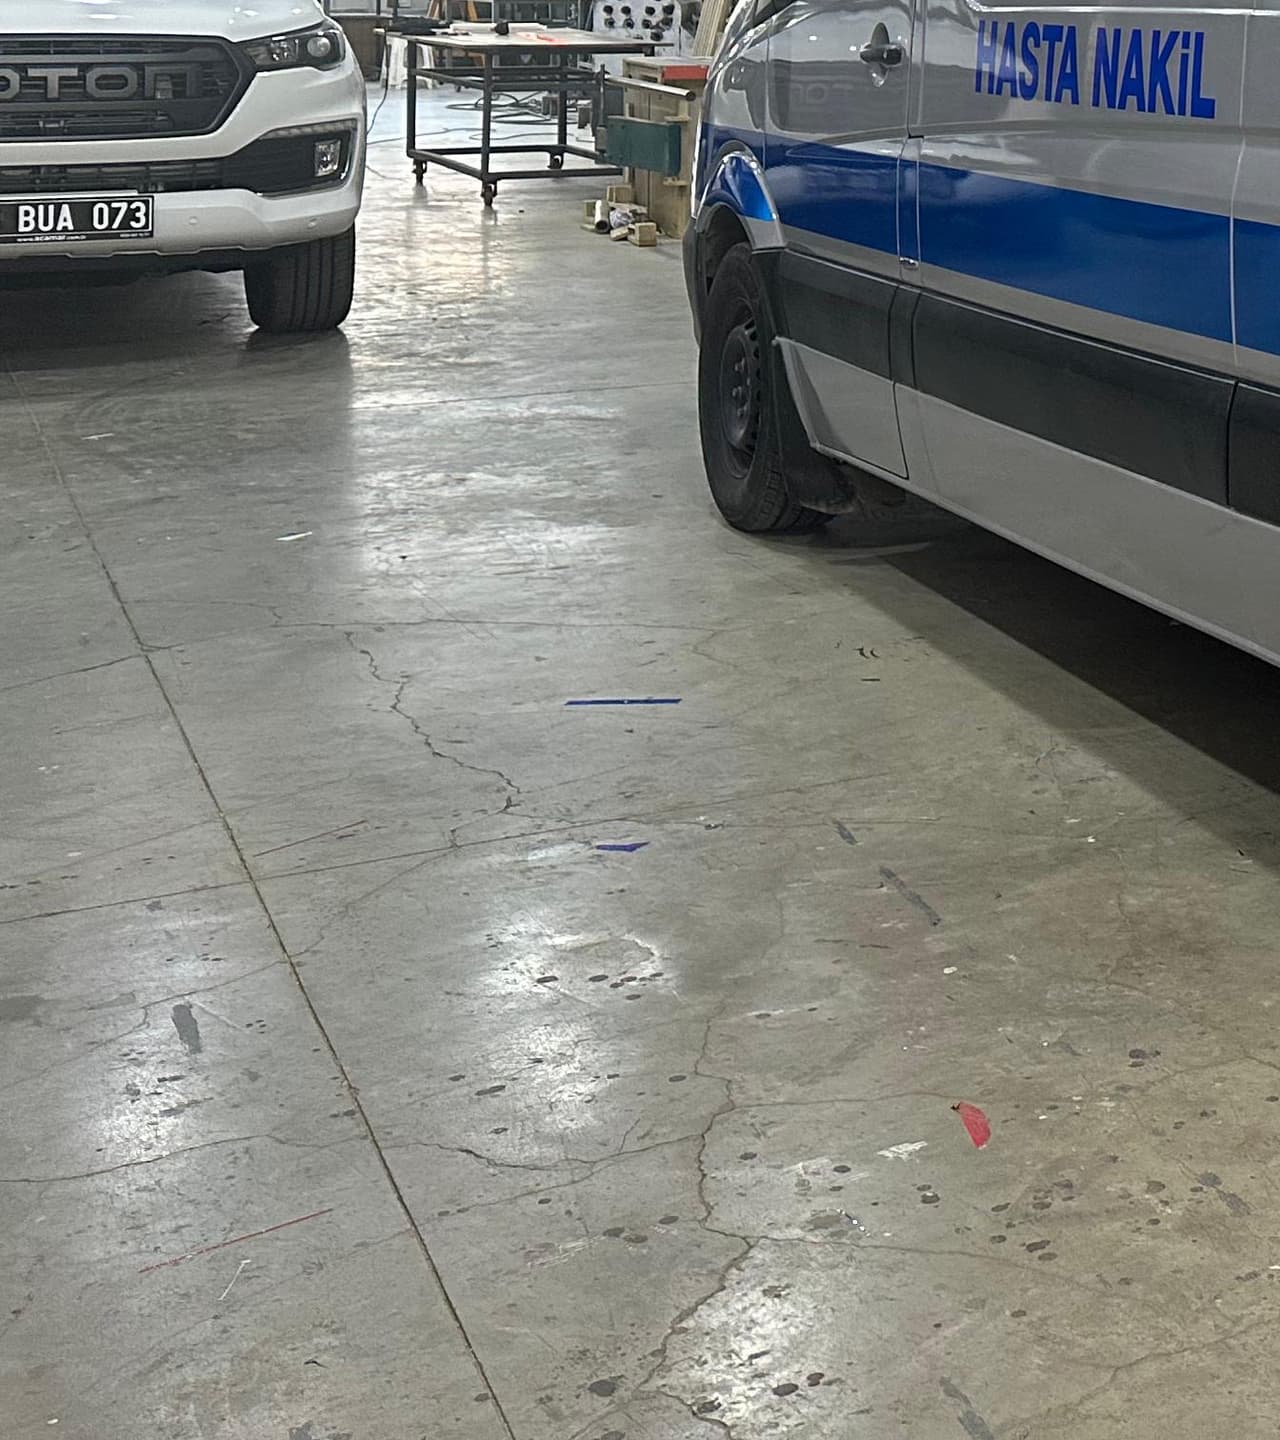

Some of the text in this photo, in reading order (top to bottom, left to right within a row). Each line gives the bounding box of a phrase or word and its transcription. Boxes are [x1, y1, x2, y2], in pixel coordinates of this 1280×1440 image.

[975, 19, 1080, 106] HASTA
[17, 201, 147, 233] BUA 073
